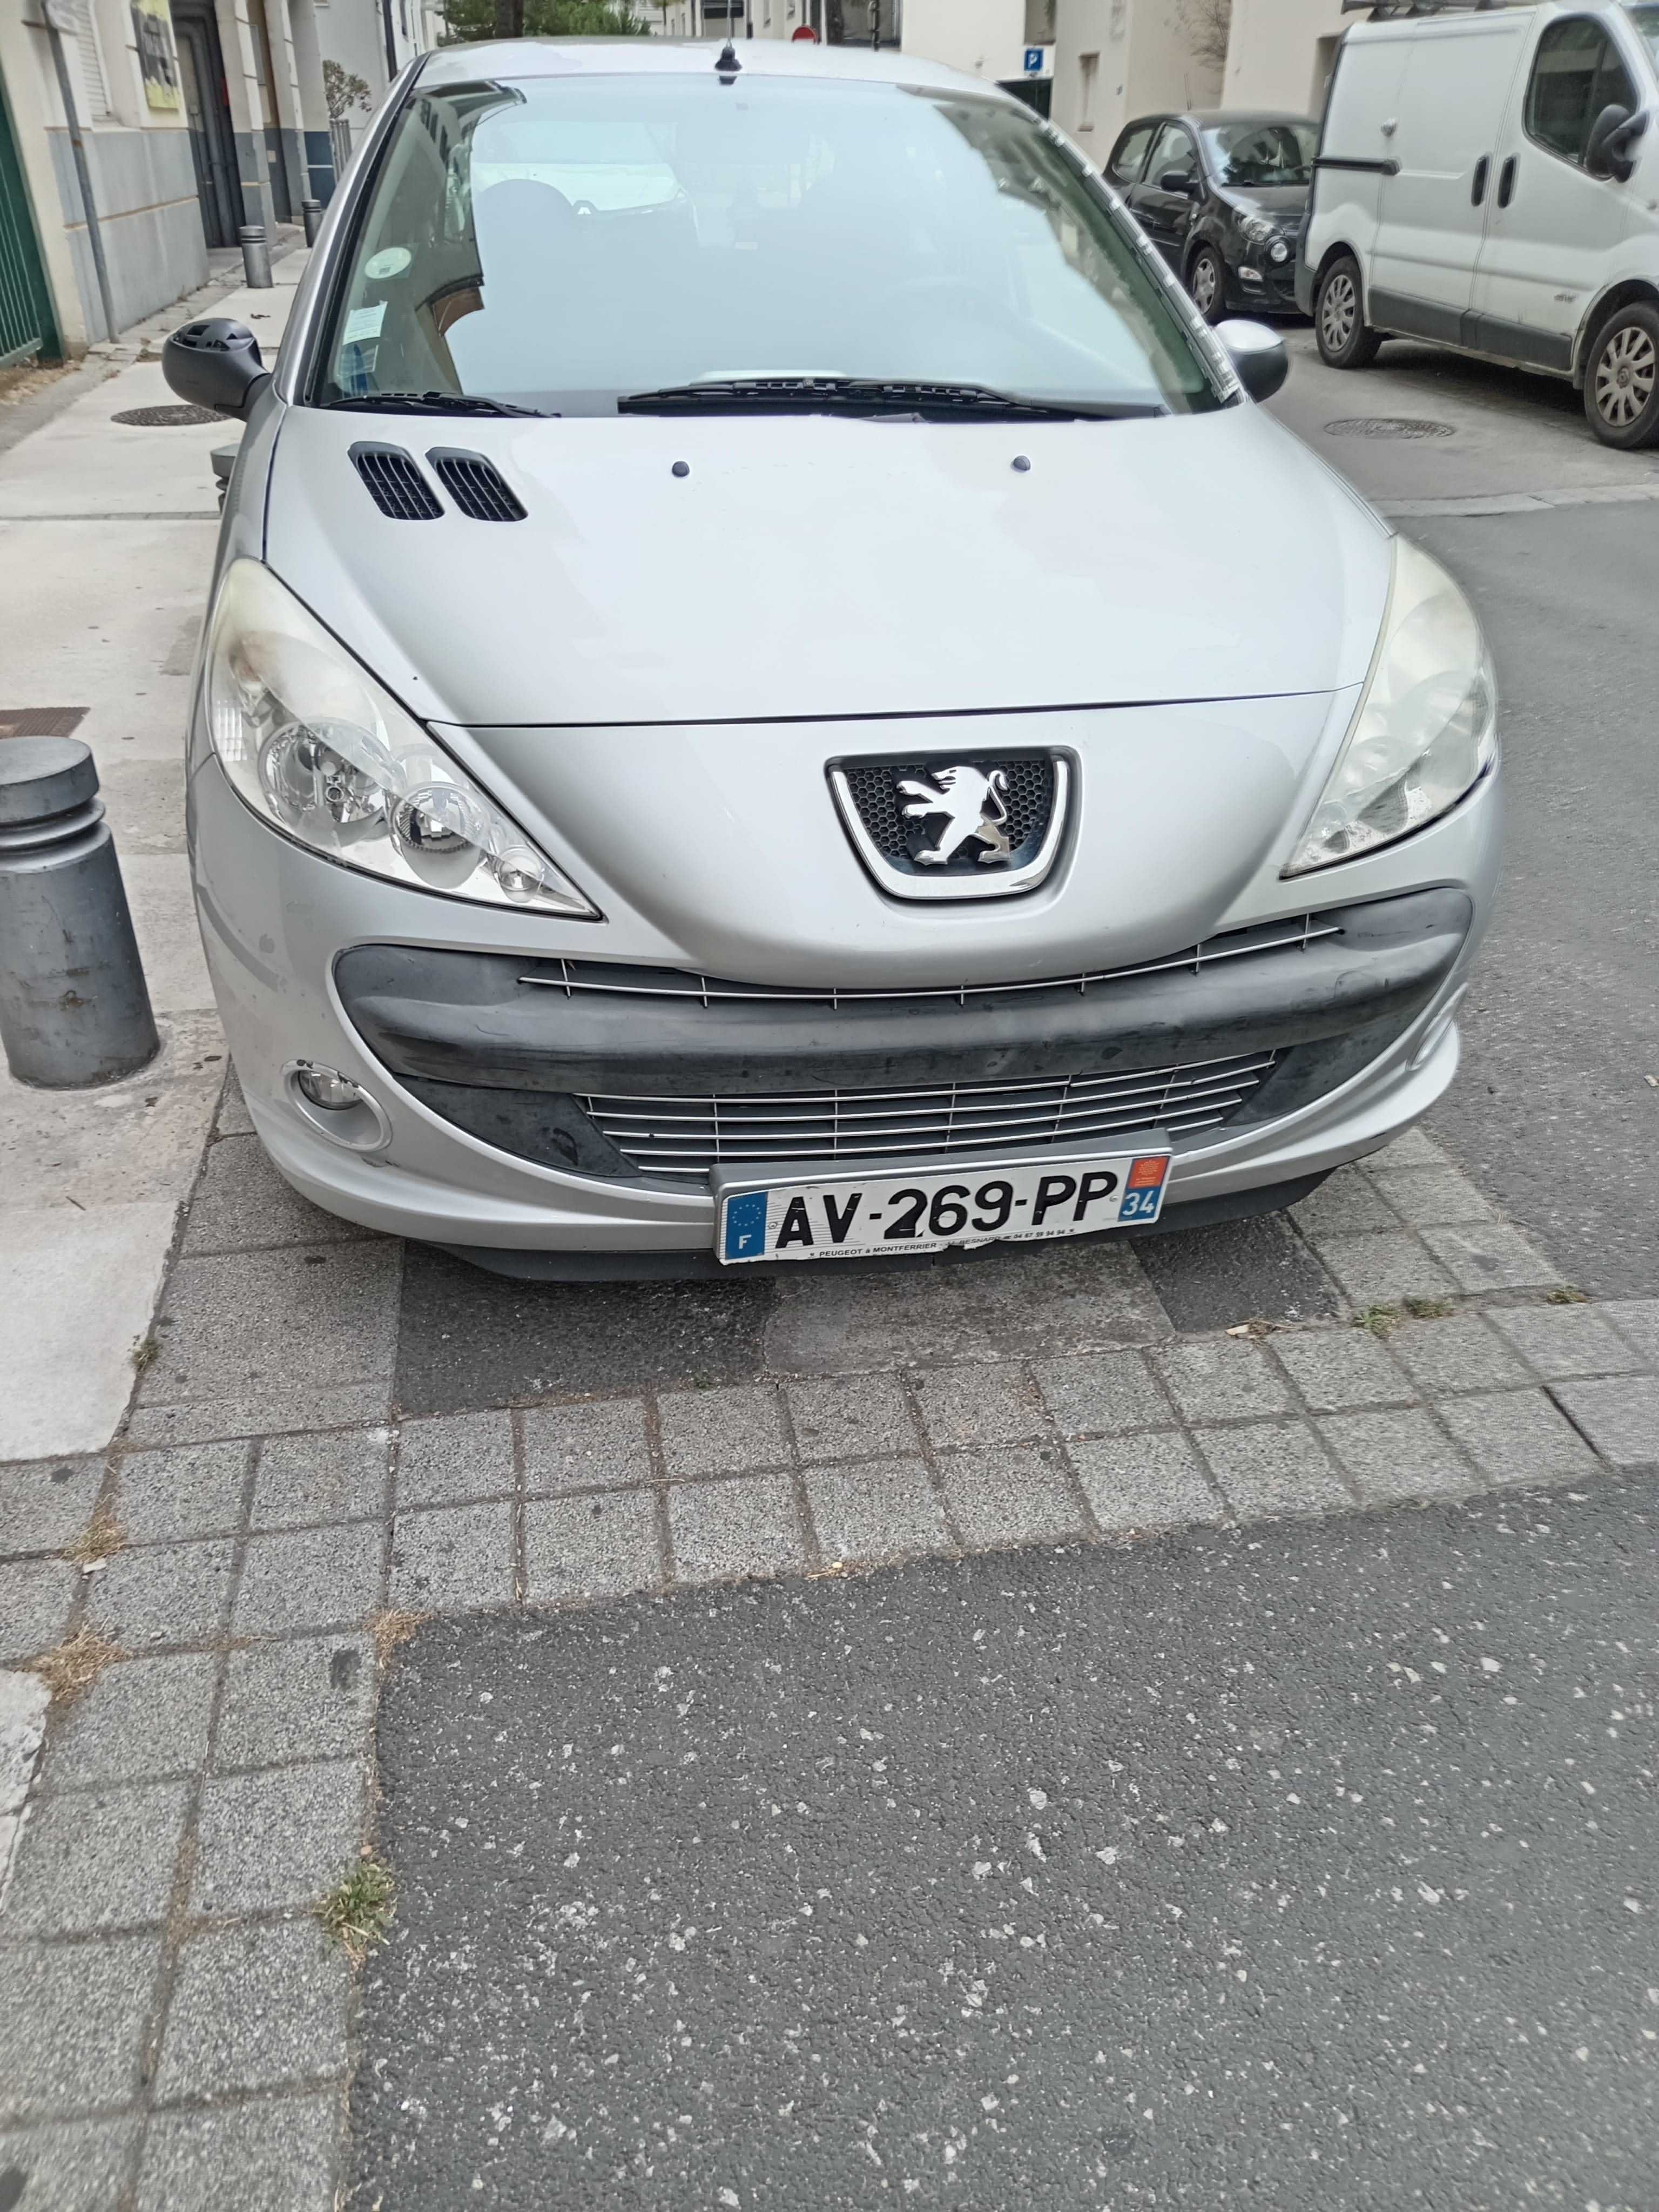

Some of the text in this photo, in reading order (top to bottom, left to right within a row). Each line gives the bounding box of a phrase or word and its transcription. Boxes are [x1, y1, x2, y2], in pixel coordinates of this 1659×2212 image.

[1028, 52, 1038, 69] P
[775, 1171, 1118, 1249] AV-269-PP
[1122, 1190, 1155, 1216] 34
[738, 1234, 752, 1250] F
[819, 1249, 864, 1257] PEUGEOT
[873, 1243, 938, 1253] MONTFERRIER
